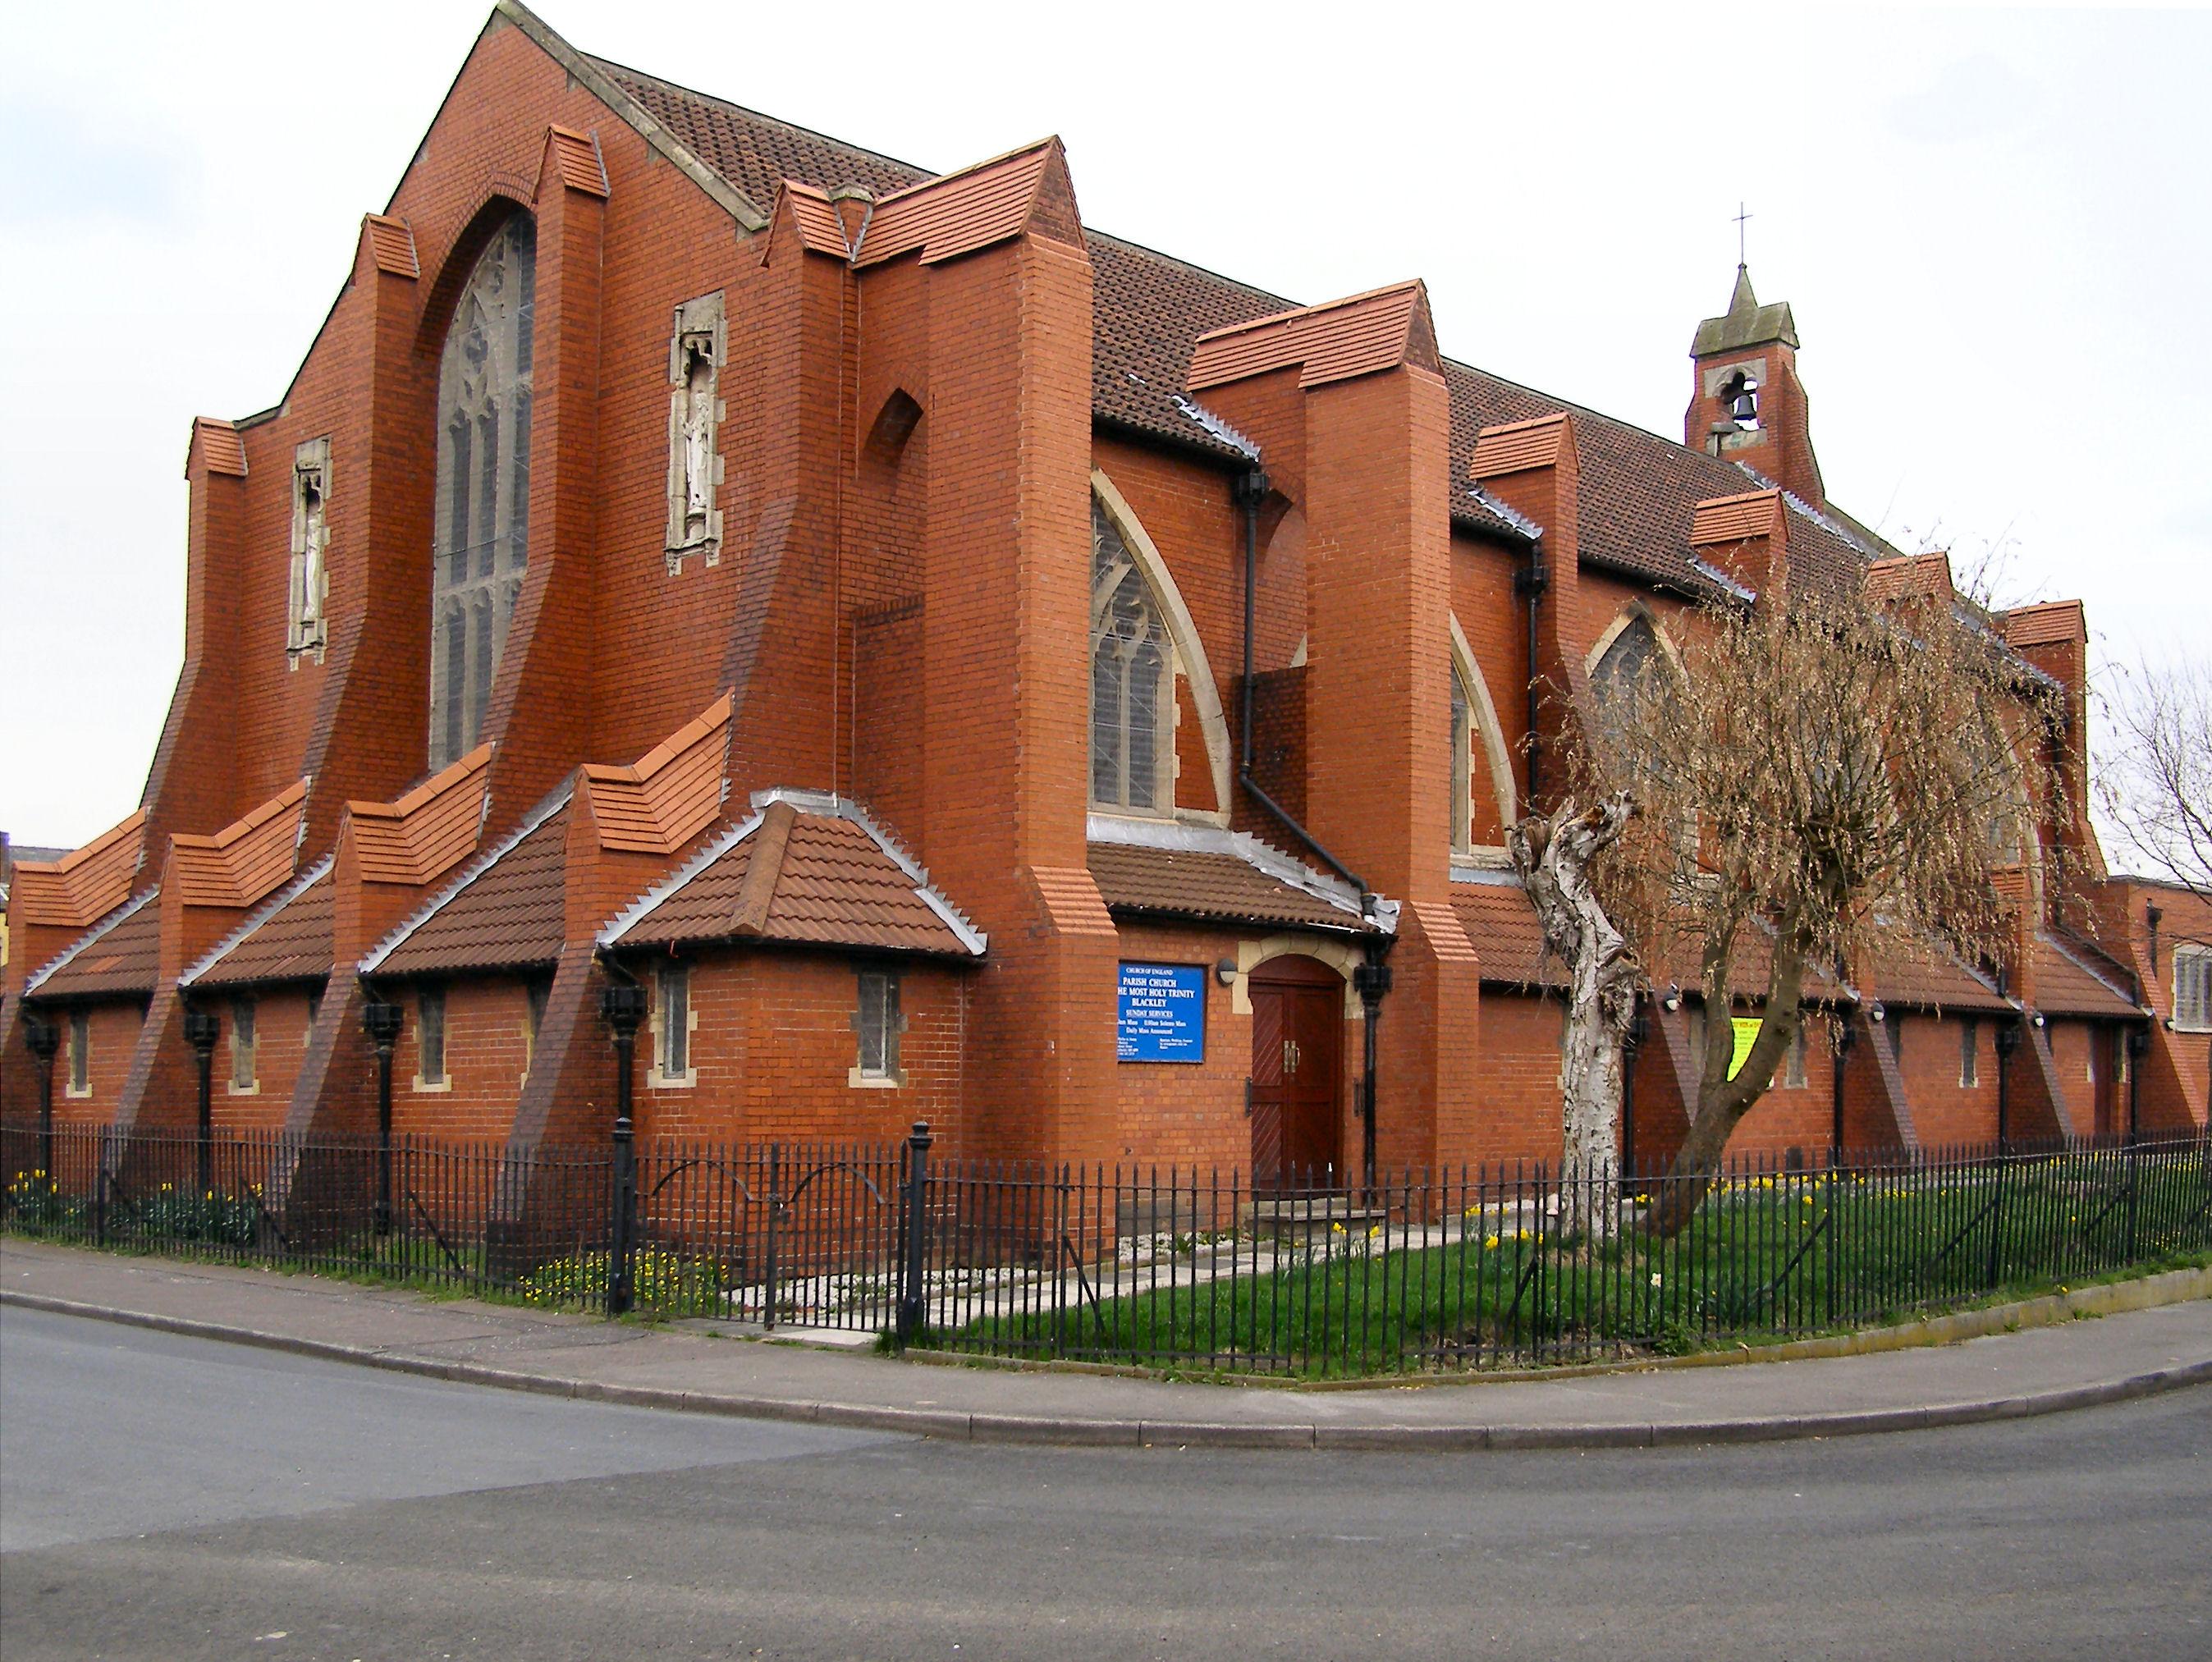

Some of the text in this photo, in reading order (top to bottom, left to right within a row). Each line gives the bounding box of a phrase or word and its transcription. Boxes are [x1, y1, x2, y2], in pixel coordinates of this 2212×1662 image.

[1123, 977, 1177, 987] PARISH CHURCH
[1129, 987, 1147, 996] MOST
[1149, 987, 1167, 996] HOLY
[1168, 988, 1195, 998] TRINITY
[1132, 997, 1167, 1007] BLACKLEY
